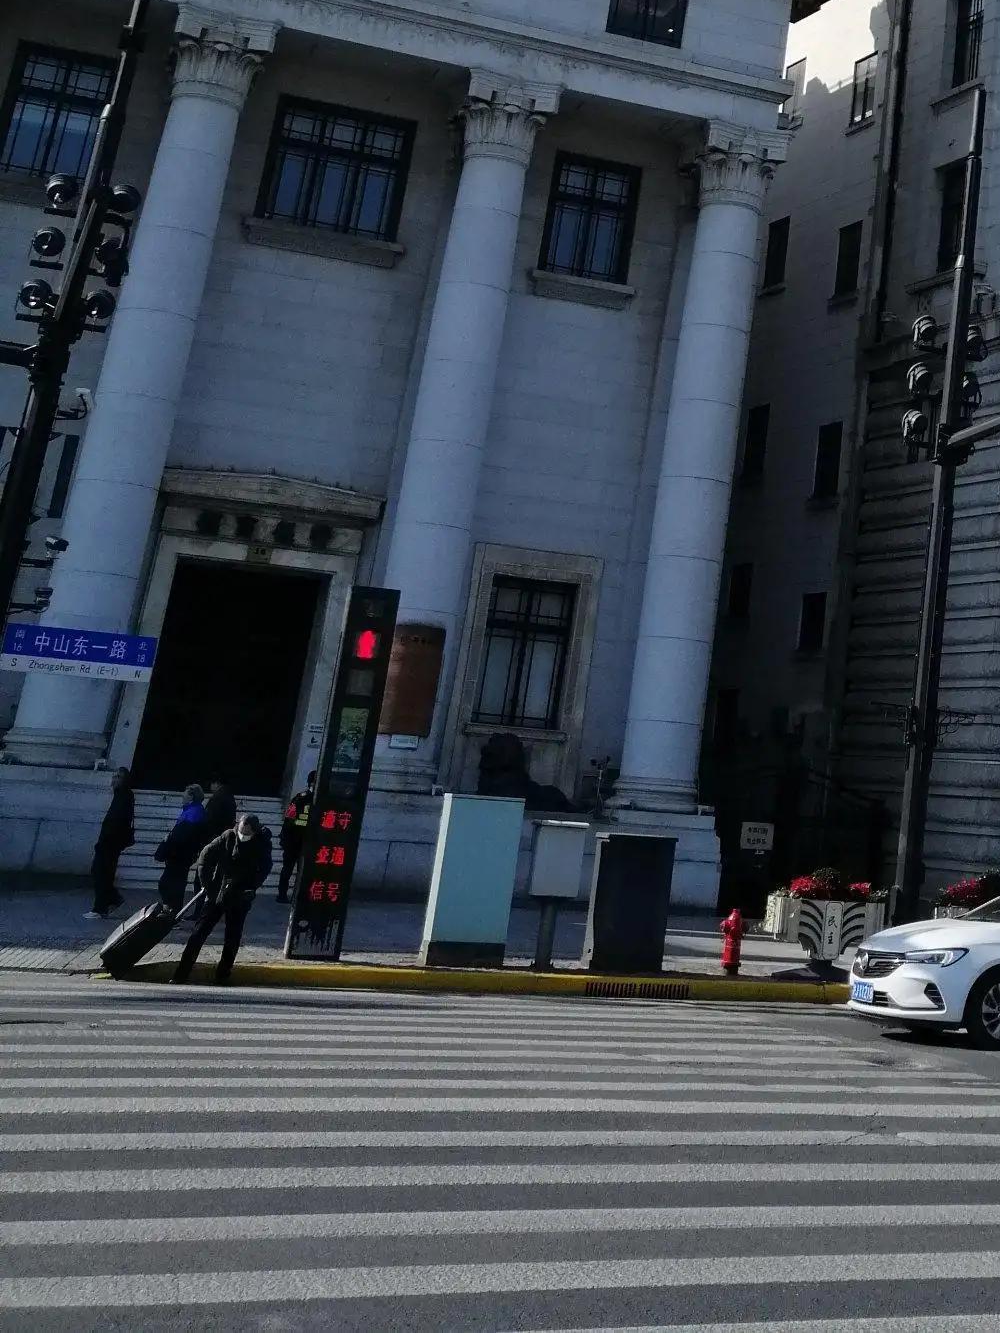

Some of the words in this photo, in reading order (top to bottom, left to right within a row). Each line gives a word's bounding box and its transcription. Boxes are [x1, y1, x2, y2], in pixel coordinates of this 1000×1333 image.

[13, 643, 22, 652] 16
[34, 632, 129, 660] 中山东一路
[138, 641, 149, 651] 北
[10, 658, 18, 667] S
[137, 654, 146, 663] 18
[29, 659, 76, 672] Zhongshan
[96, 665, 119, 677] (E-1)
[134, 670, 142, 678] N
[320, 810, 352, 831] 遵守
[314, 845, 346, 866] 交通
[308, 881, 341, 904] 信号
